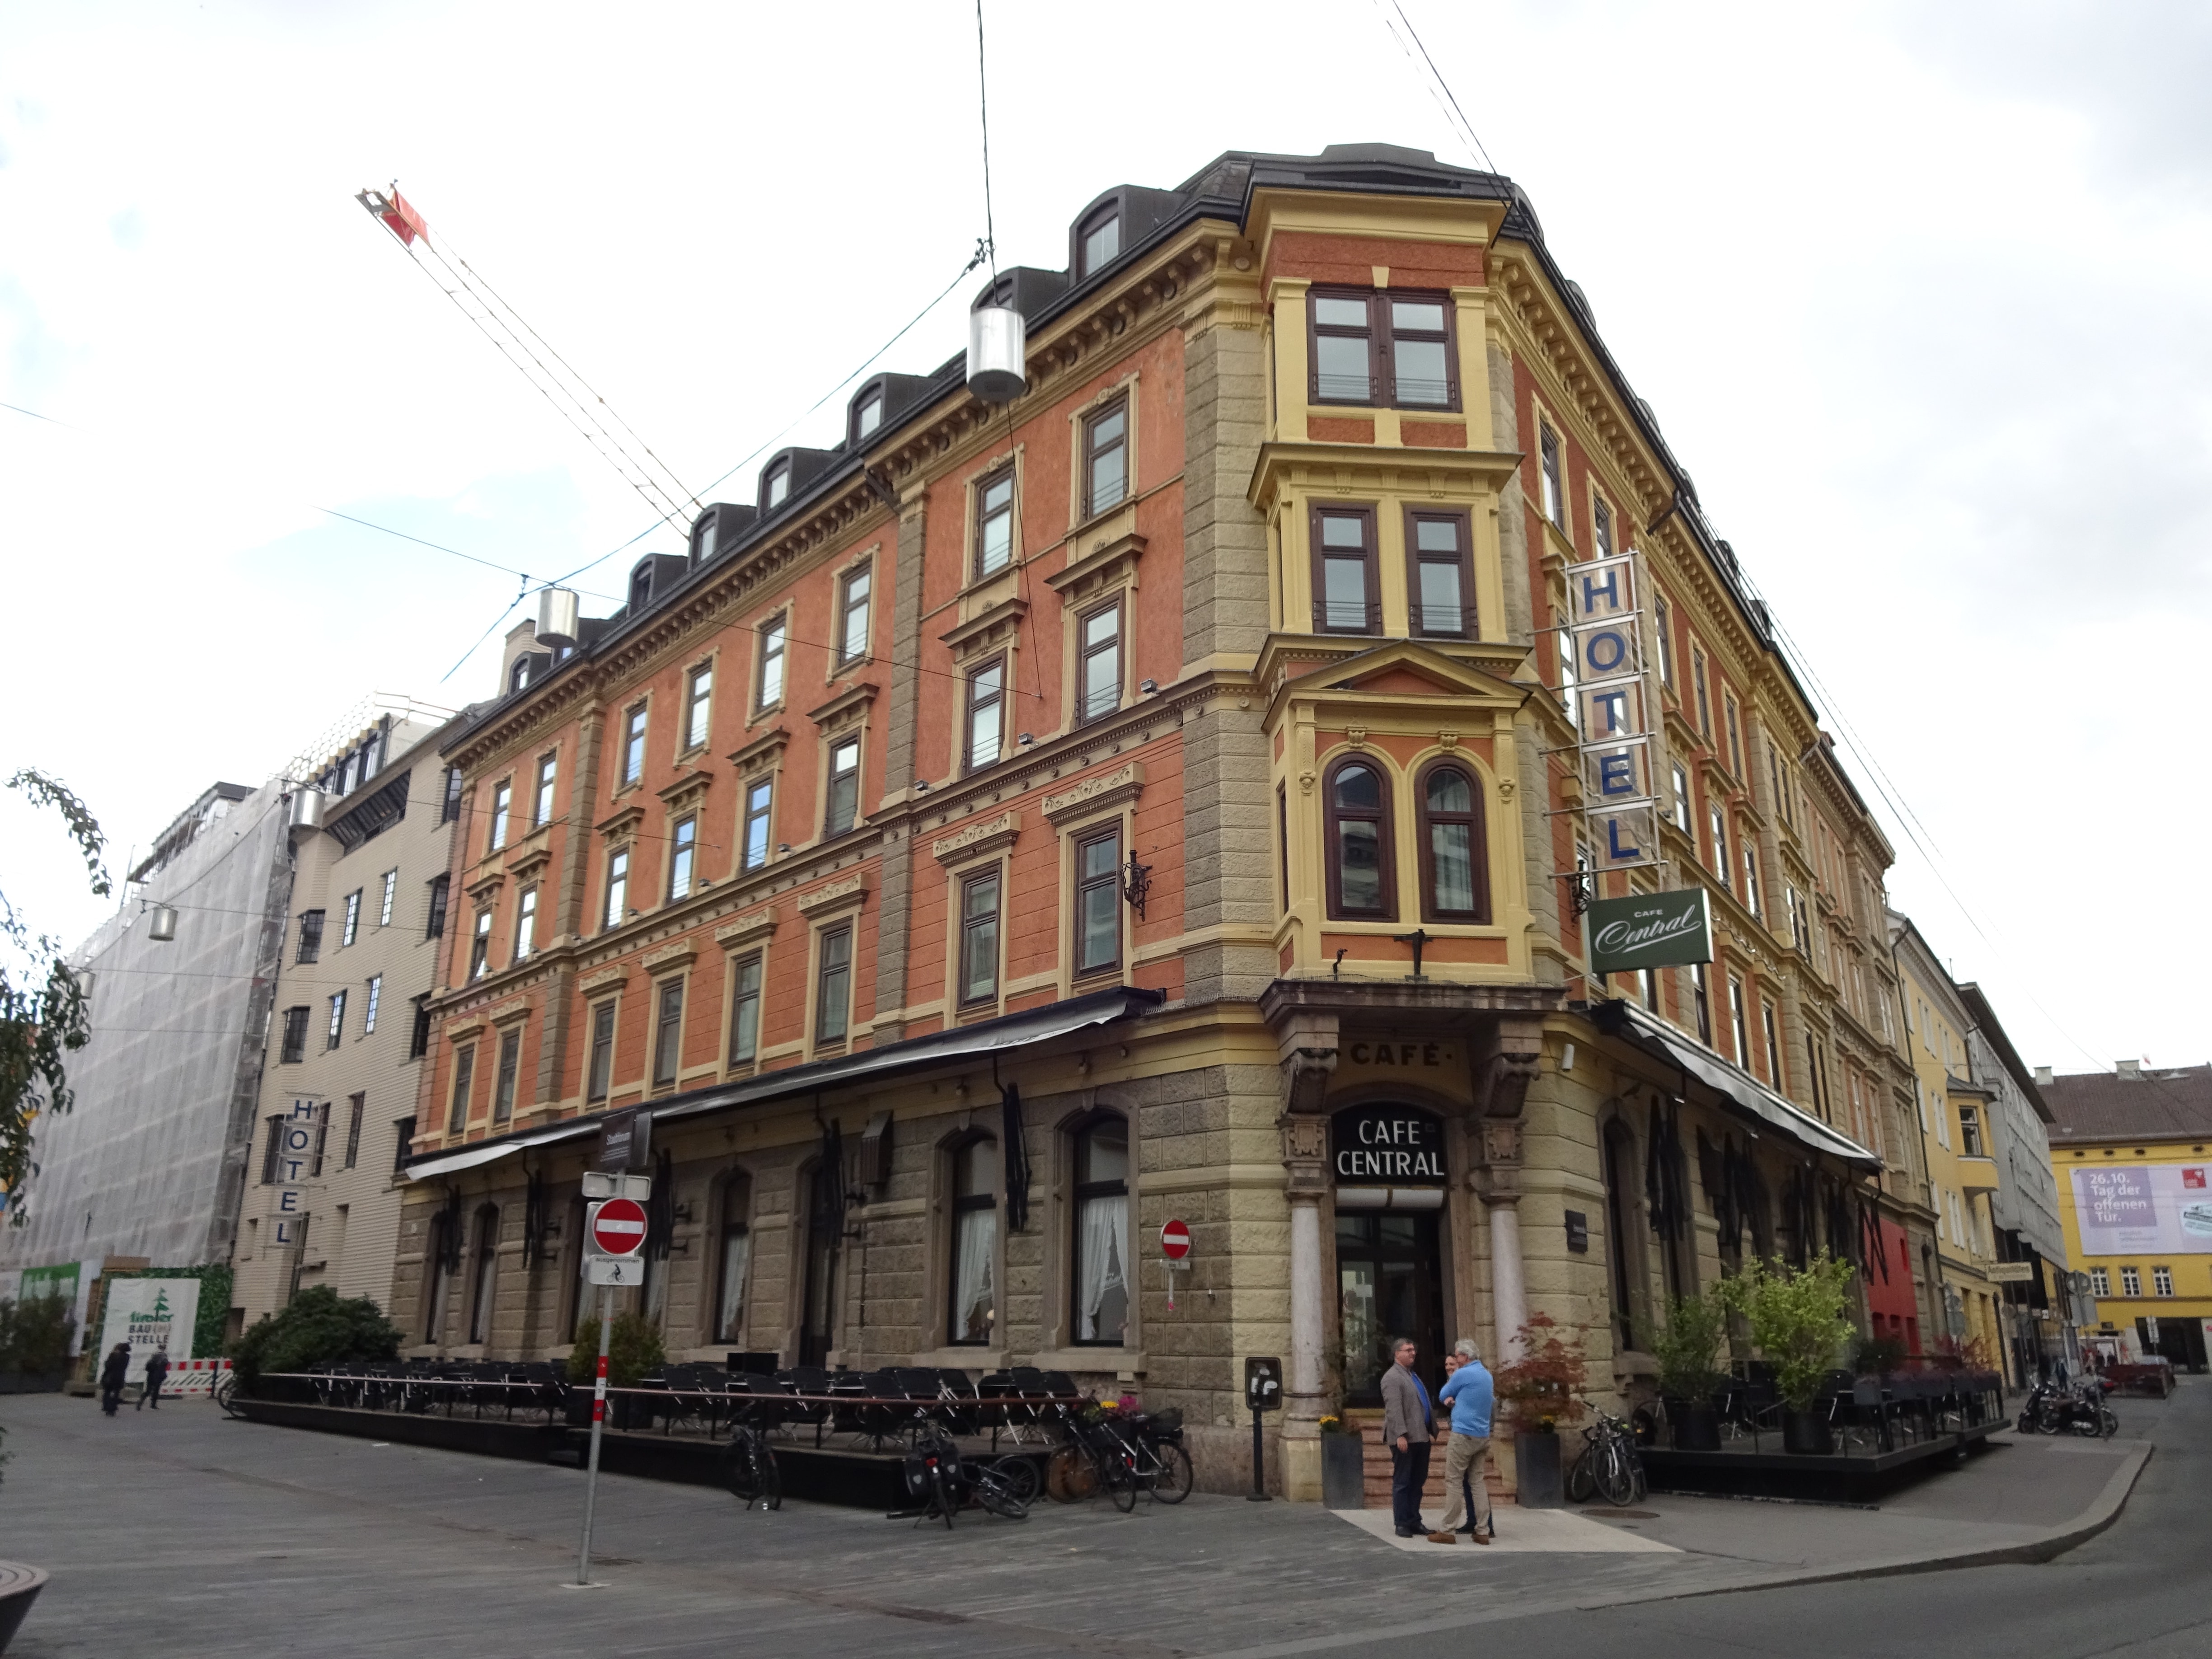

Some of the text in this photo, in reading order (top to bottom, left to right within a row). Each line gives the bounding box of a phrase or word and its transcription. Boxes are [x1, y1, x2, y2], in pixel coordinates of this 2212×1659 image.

[1583, 571, 1640, 859] HOTEL
[1634, 909, 1664, 918] CAFE
[1595, 904, 1702, 954] Central
[1359, 1120, 1420, 1144] CAFE
[277, 1100, 312, 1243] HOTEL
[1337, 1151, 1445, 1176] CENTRAL
[2090, 1172, 2130, 1185] 26.10.
[2090, 1183, 2141, 1198] Tag der
[2093, 1198, 2146, 1210] offenen
[127, 1335, 169, 1345] STELLE
